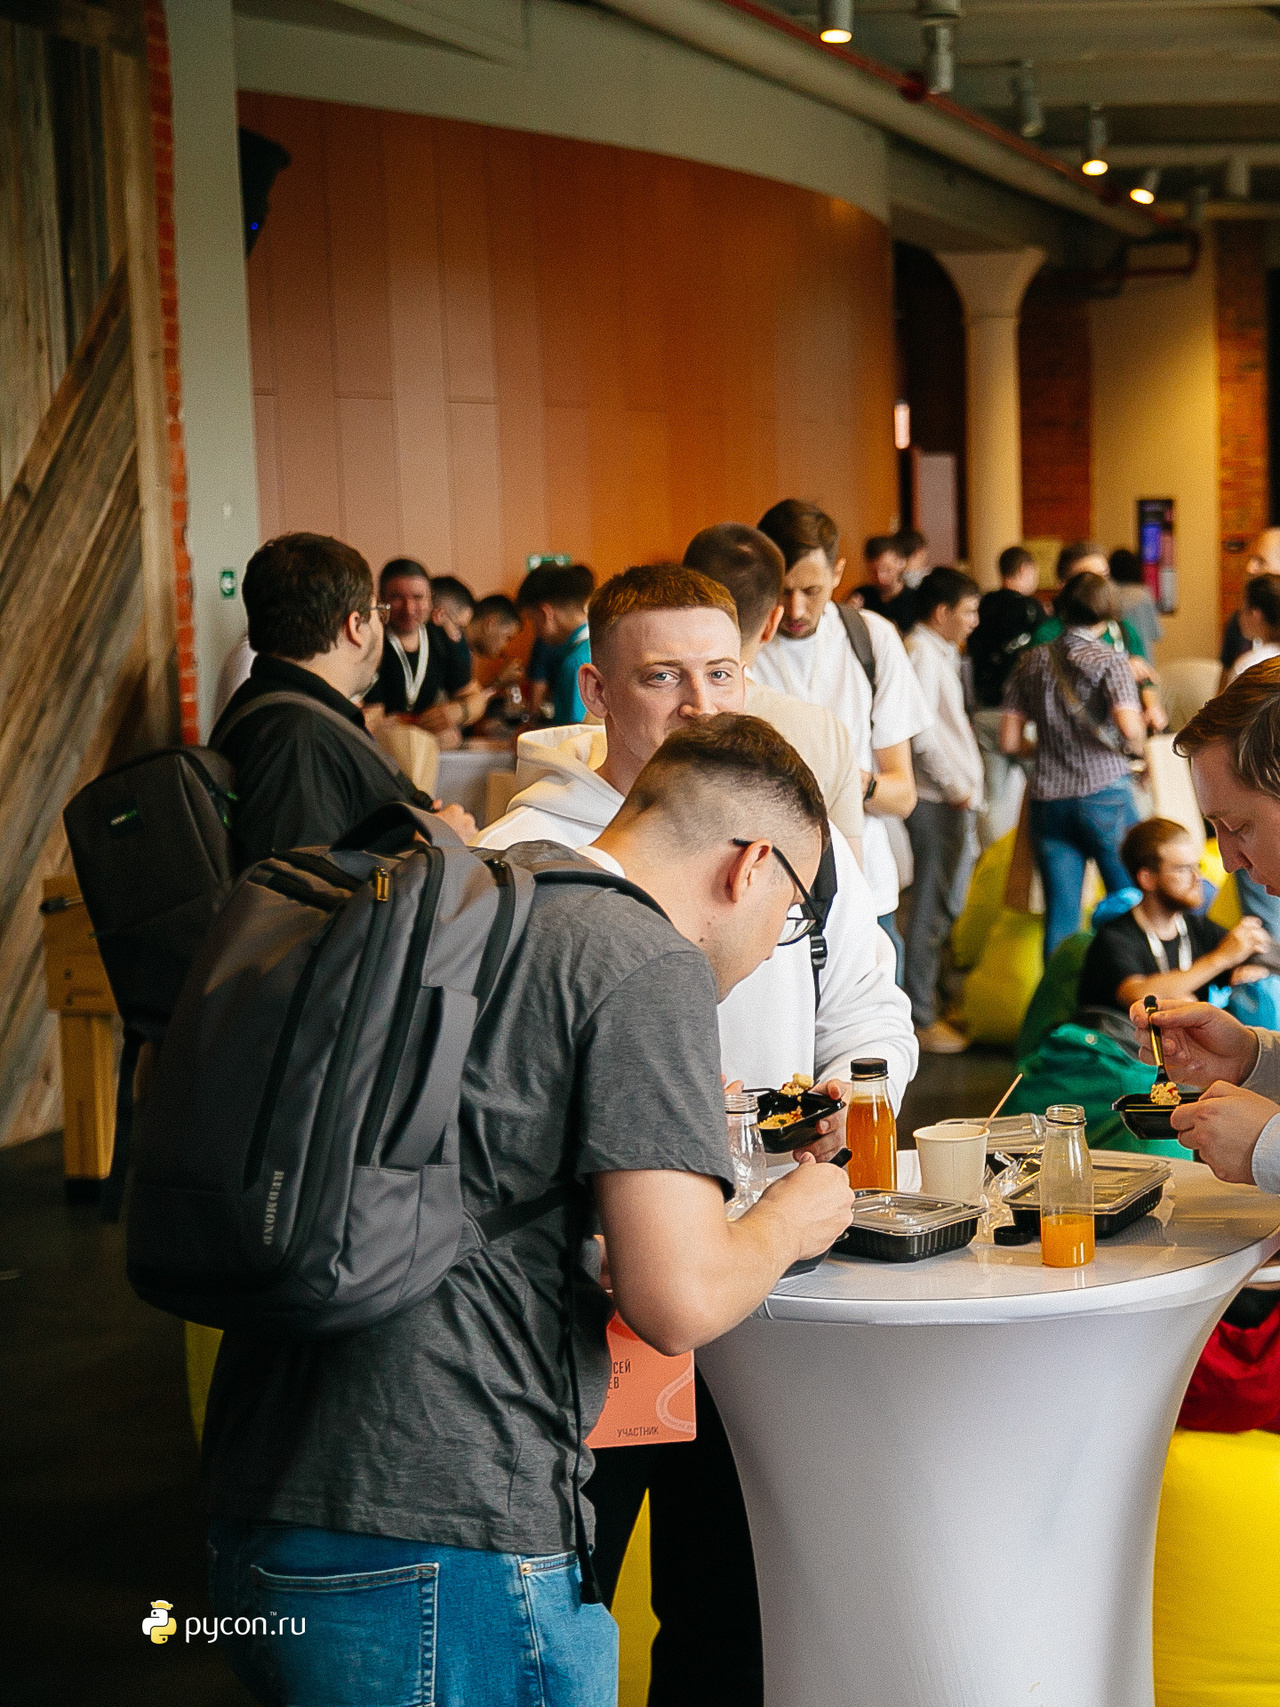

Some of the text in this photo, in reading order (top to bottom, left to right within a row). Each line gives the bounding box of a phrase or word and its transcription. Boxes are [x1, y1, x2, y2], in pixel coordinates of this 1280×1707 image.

[263, 1170, 285, 1246] REDMOND
[612, 1359, 631, 1374] СЕЙ
[616, 1426, 660, 1438] УЧАСТНИК
